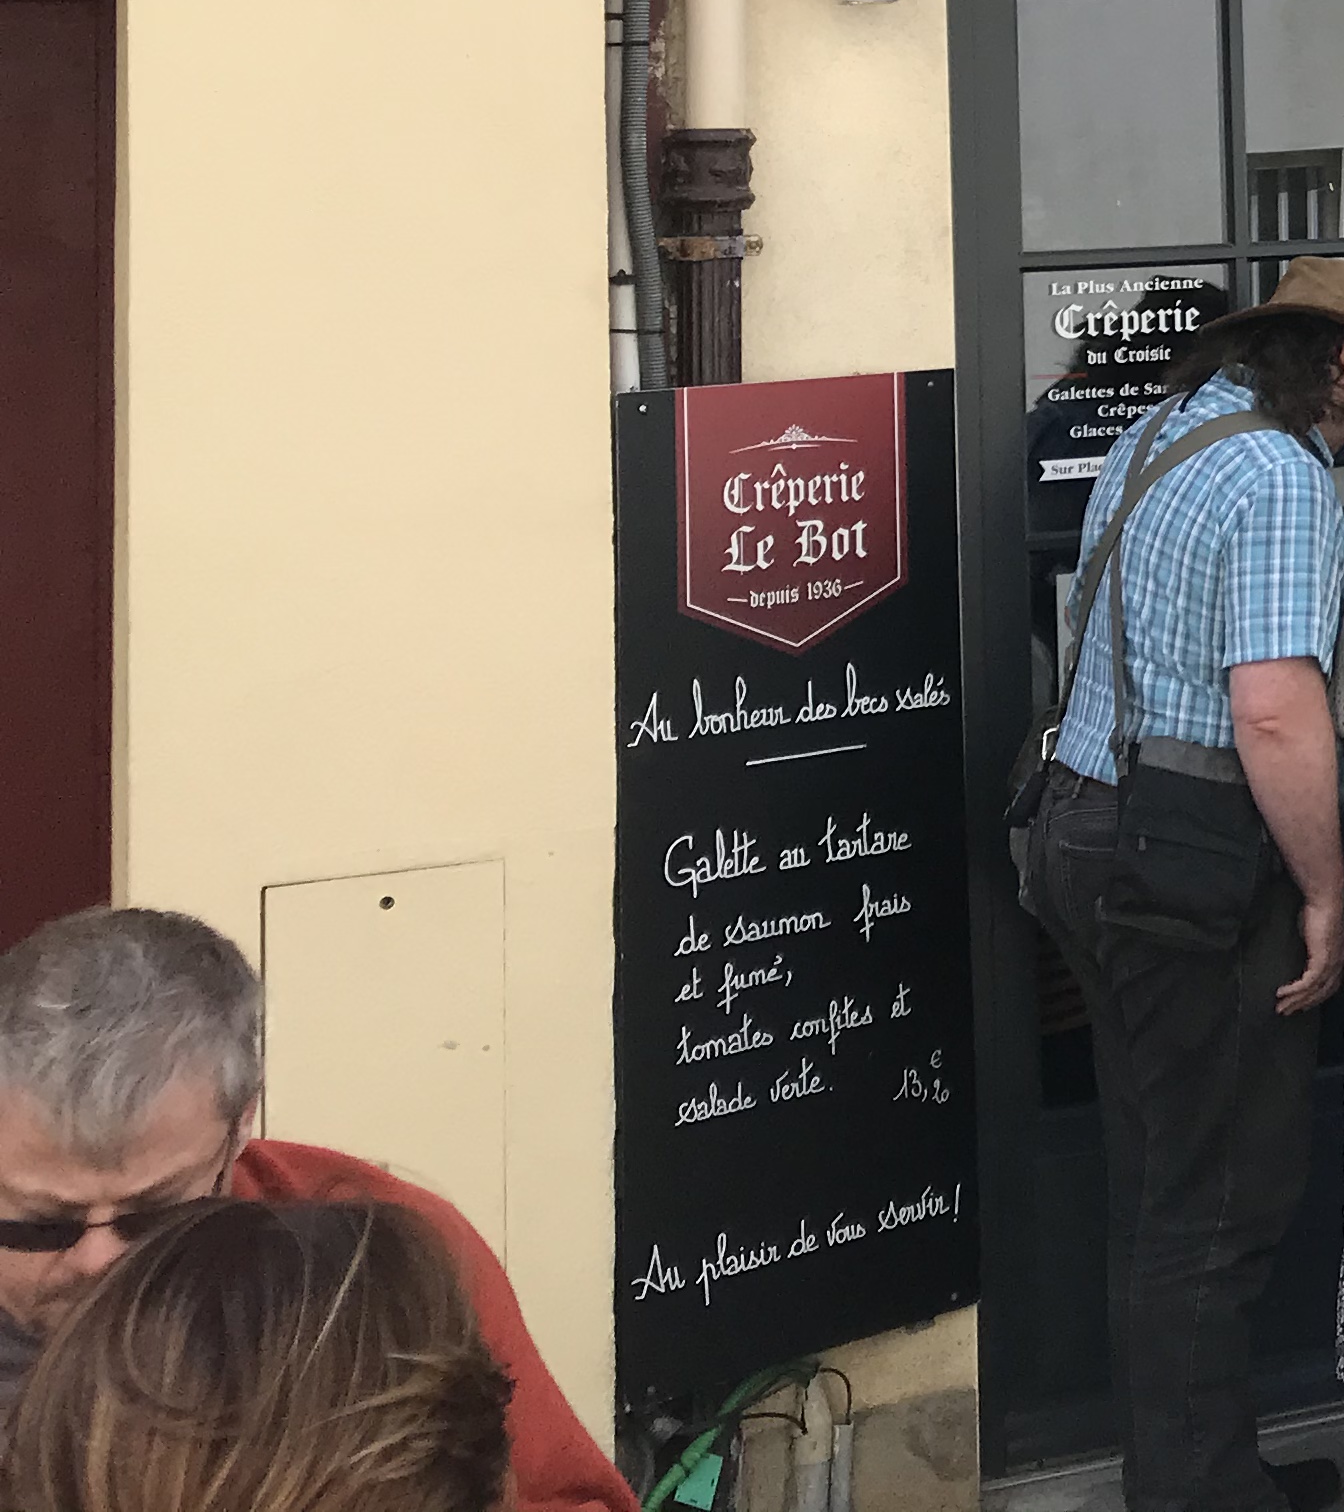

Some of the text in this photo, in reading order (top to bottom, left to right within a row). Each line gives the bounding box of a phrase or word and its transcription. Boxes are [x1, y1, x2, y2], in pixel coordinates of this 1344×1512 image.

[1051, 277, 1204, 296] La Plus Ancienne
[1054, 299, 1201, 342] Crêperie
[1086, 345, 1171, 365] du Croisic
[1047, 383, 1115, 402] Galettes
[1119, 383, 1139, 396] de
[1069, 424, 1124, 439] Glaces
[723, 462, 866, 517] Crêperie
[1051, 464, 1074, 476] Sur
[721, 519, 868, 575] Le Bot
[749, 579, 842, 610] depuis 1936
[626, 663, 950, 748] Au bonheur des becs salés
[664, 813, 913, 898] Galette au tartare
[674, 884, 912, 957] de saumon frais
[675, 955, 793, 1014] et fumé,
[676, 983, 912, 1065] tomates confites et
[675, 1057, 834, 1126] salade verte.
[631, 1245, 685, 1301] Au
[696, 1233, 782, 1306] plaisir
[787, 1220, 819, 1259] de
[827, 1212, 867, 1247] vous
